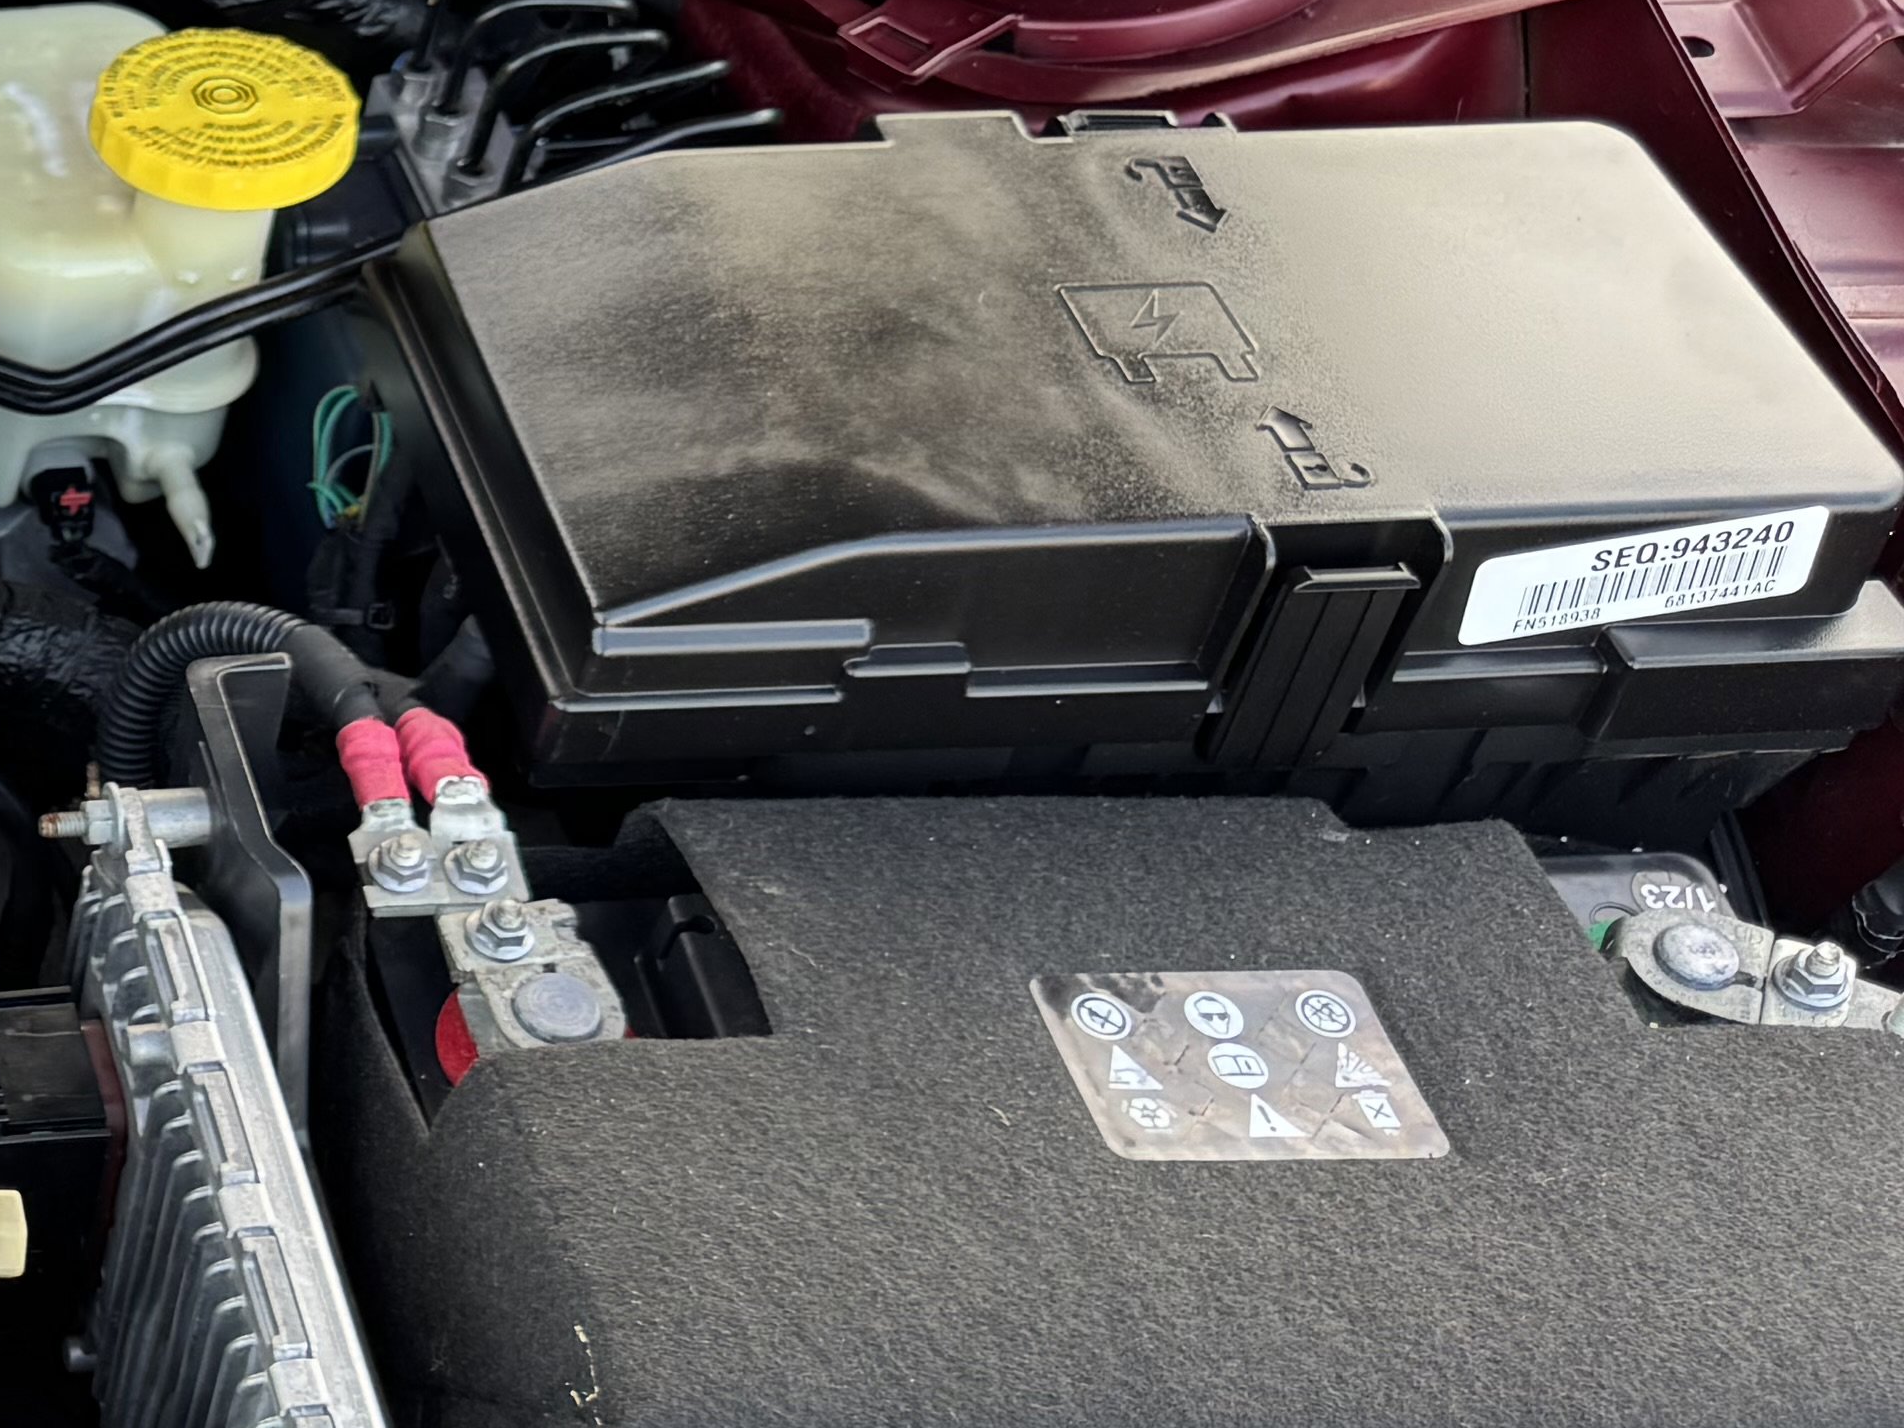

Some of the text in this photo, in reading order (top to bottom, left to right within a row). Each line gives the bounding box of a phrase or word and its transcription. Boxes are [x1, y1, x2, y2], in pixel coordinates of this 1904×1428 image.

[1591, 521, 1794, 572] SEQ:943240
[1664, 580, 1777, 609] 68137441AC
[1512, 608, 1601, 633] FN518938
